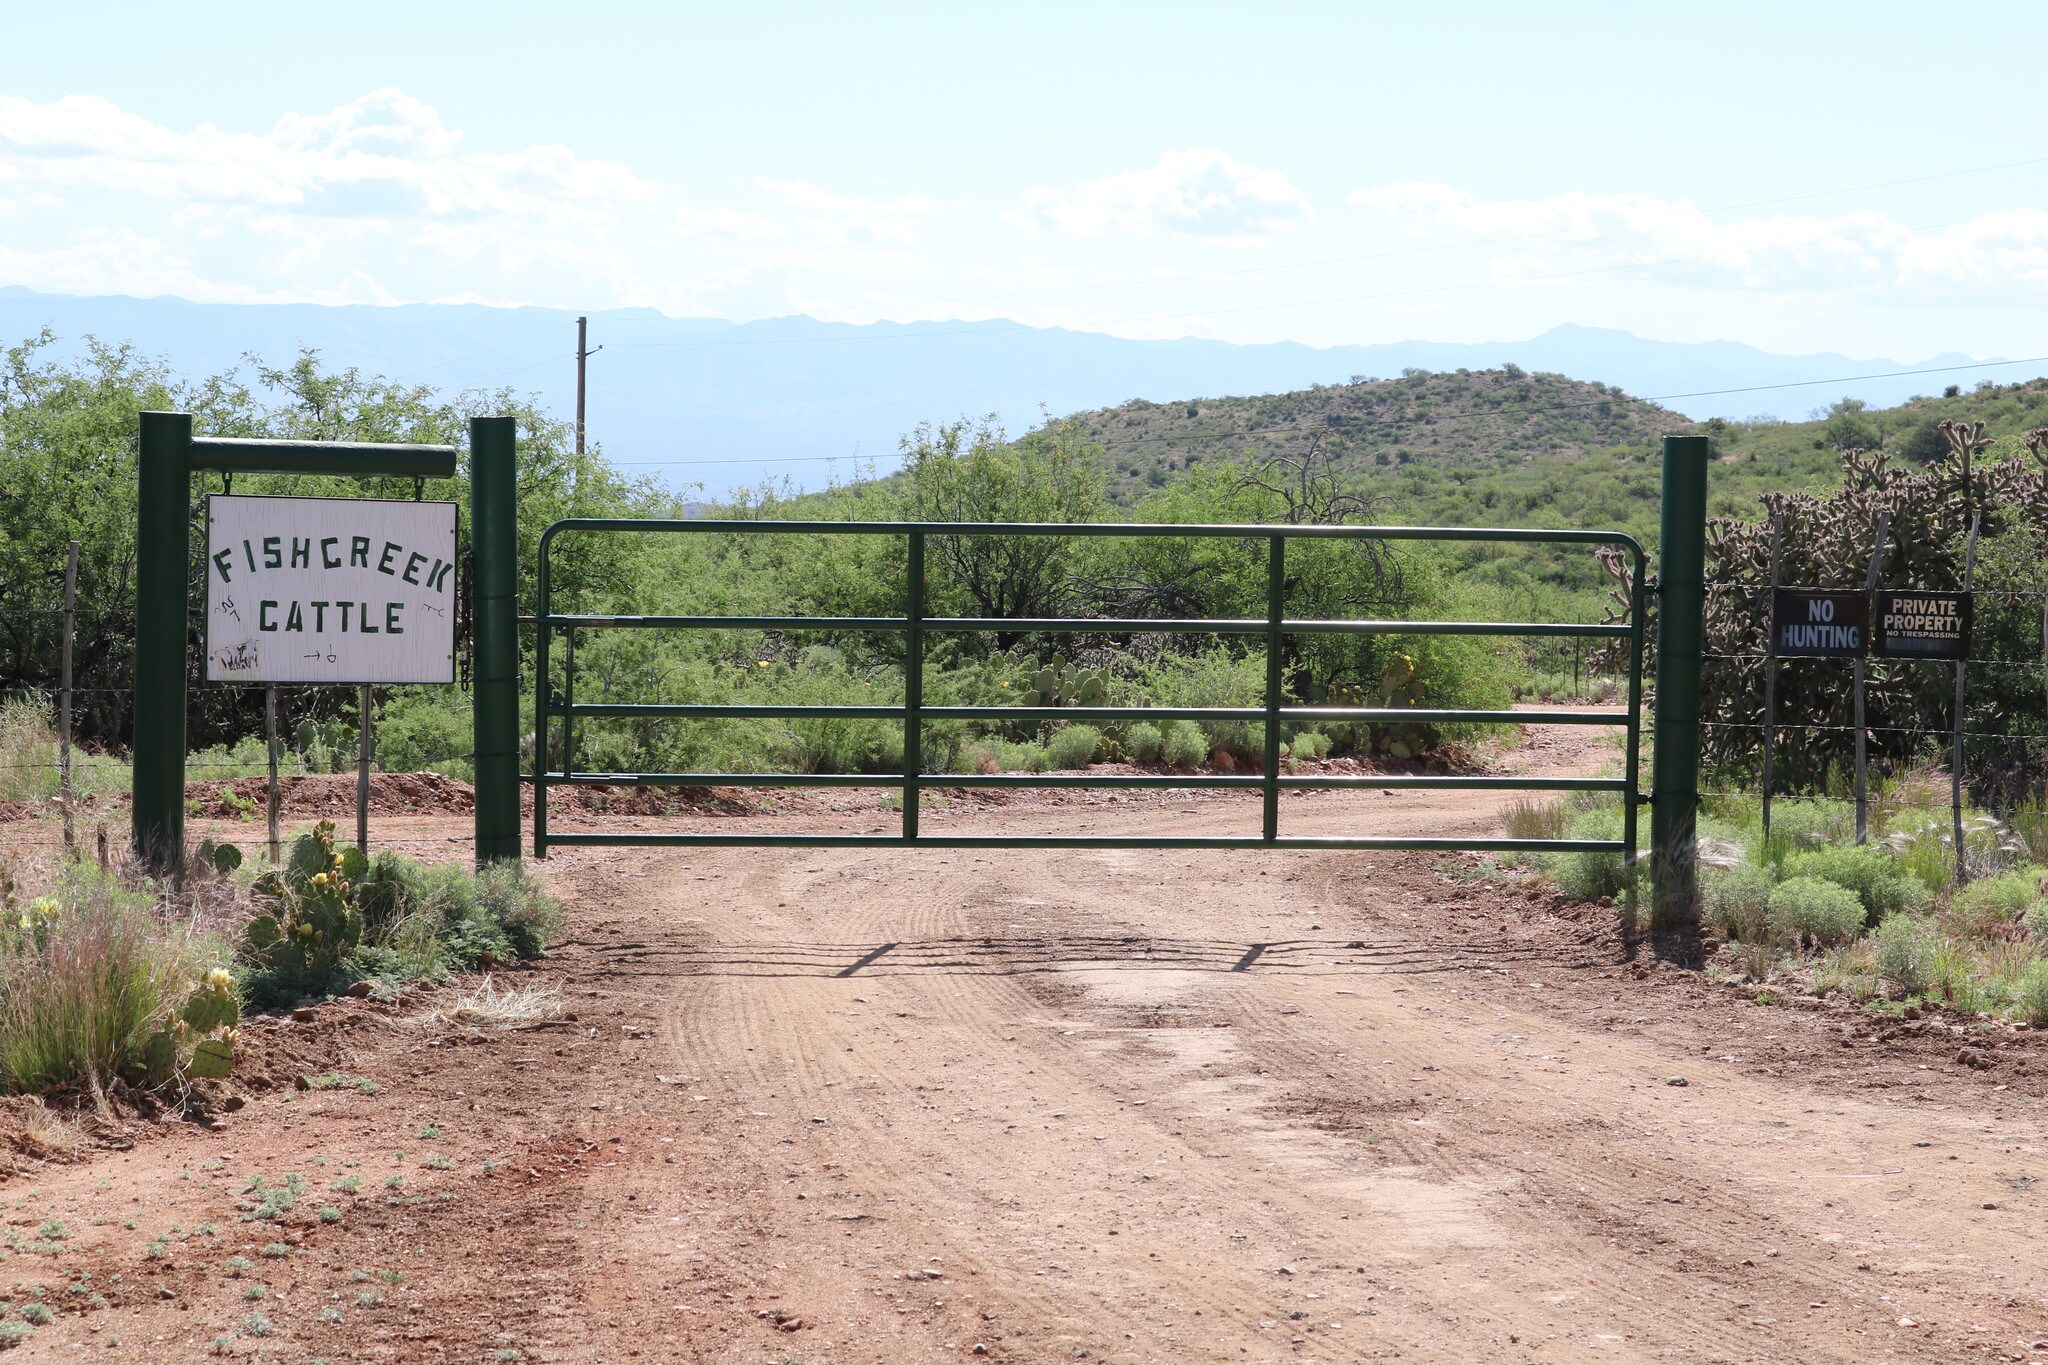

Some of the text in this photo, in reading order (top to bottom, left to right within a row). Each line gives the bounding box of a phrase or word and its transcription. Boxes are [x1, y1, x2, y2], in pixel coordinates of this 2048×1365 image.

[213, 536, 454, 593] FISHCREEK
[259, 600, 404, 633] CATTLE
[1808, 599, 1834, 622] NO
[1892, 599, 1957, 615] PRIVATE
[1884, 615, 1963, 631] PROPERTY
[1781, 625, 1860, 648] HUNTING
[1901, 631, 1960, 639] TRESPASSING
